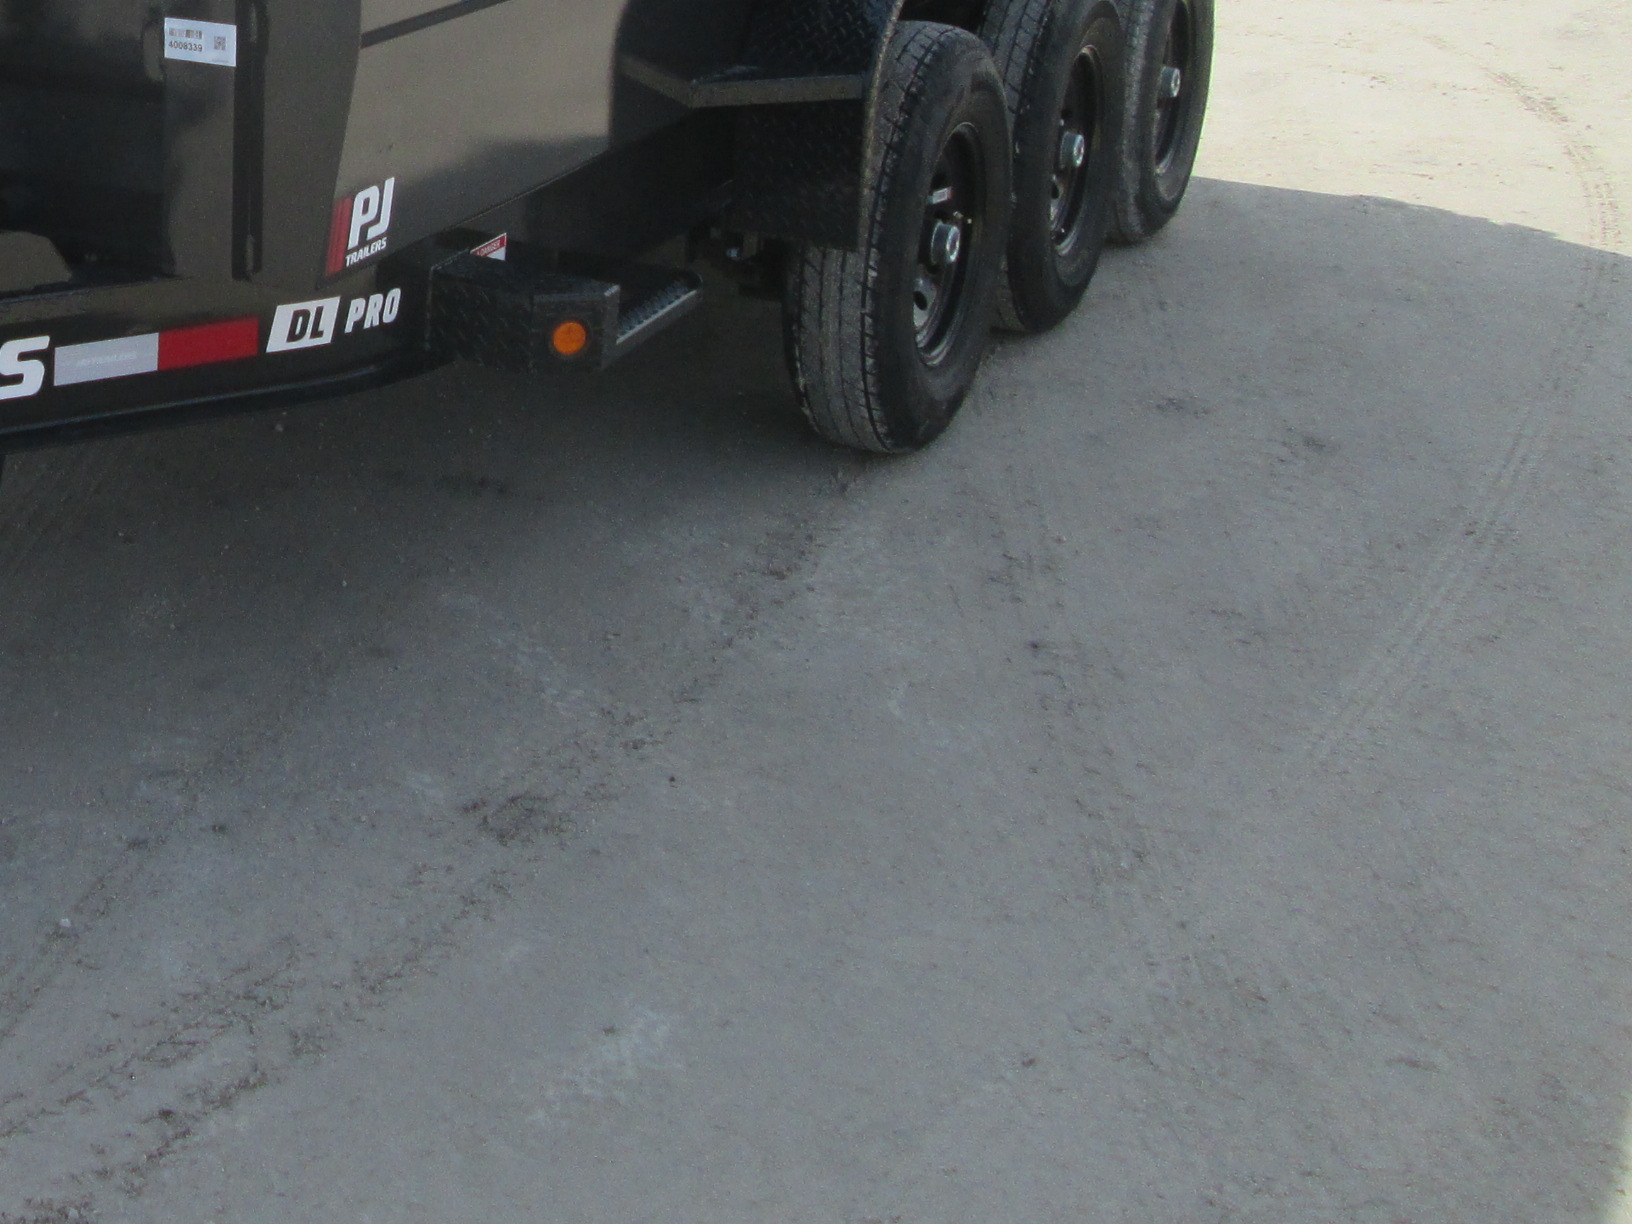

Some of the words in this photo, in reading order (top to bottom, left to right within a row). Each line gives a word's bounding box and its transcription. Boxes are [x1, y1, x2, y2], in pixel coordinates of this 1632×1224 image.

[169, 40, 203, 53] 4008339
[347, 177, 396, 251] PJ
[345, 236, 388, 268] TRAILERS
[285, 305, 327, 344] DL
[344, 287, 402, 334] PRO
